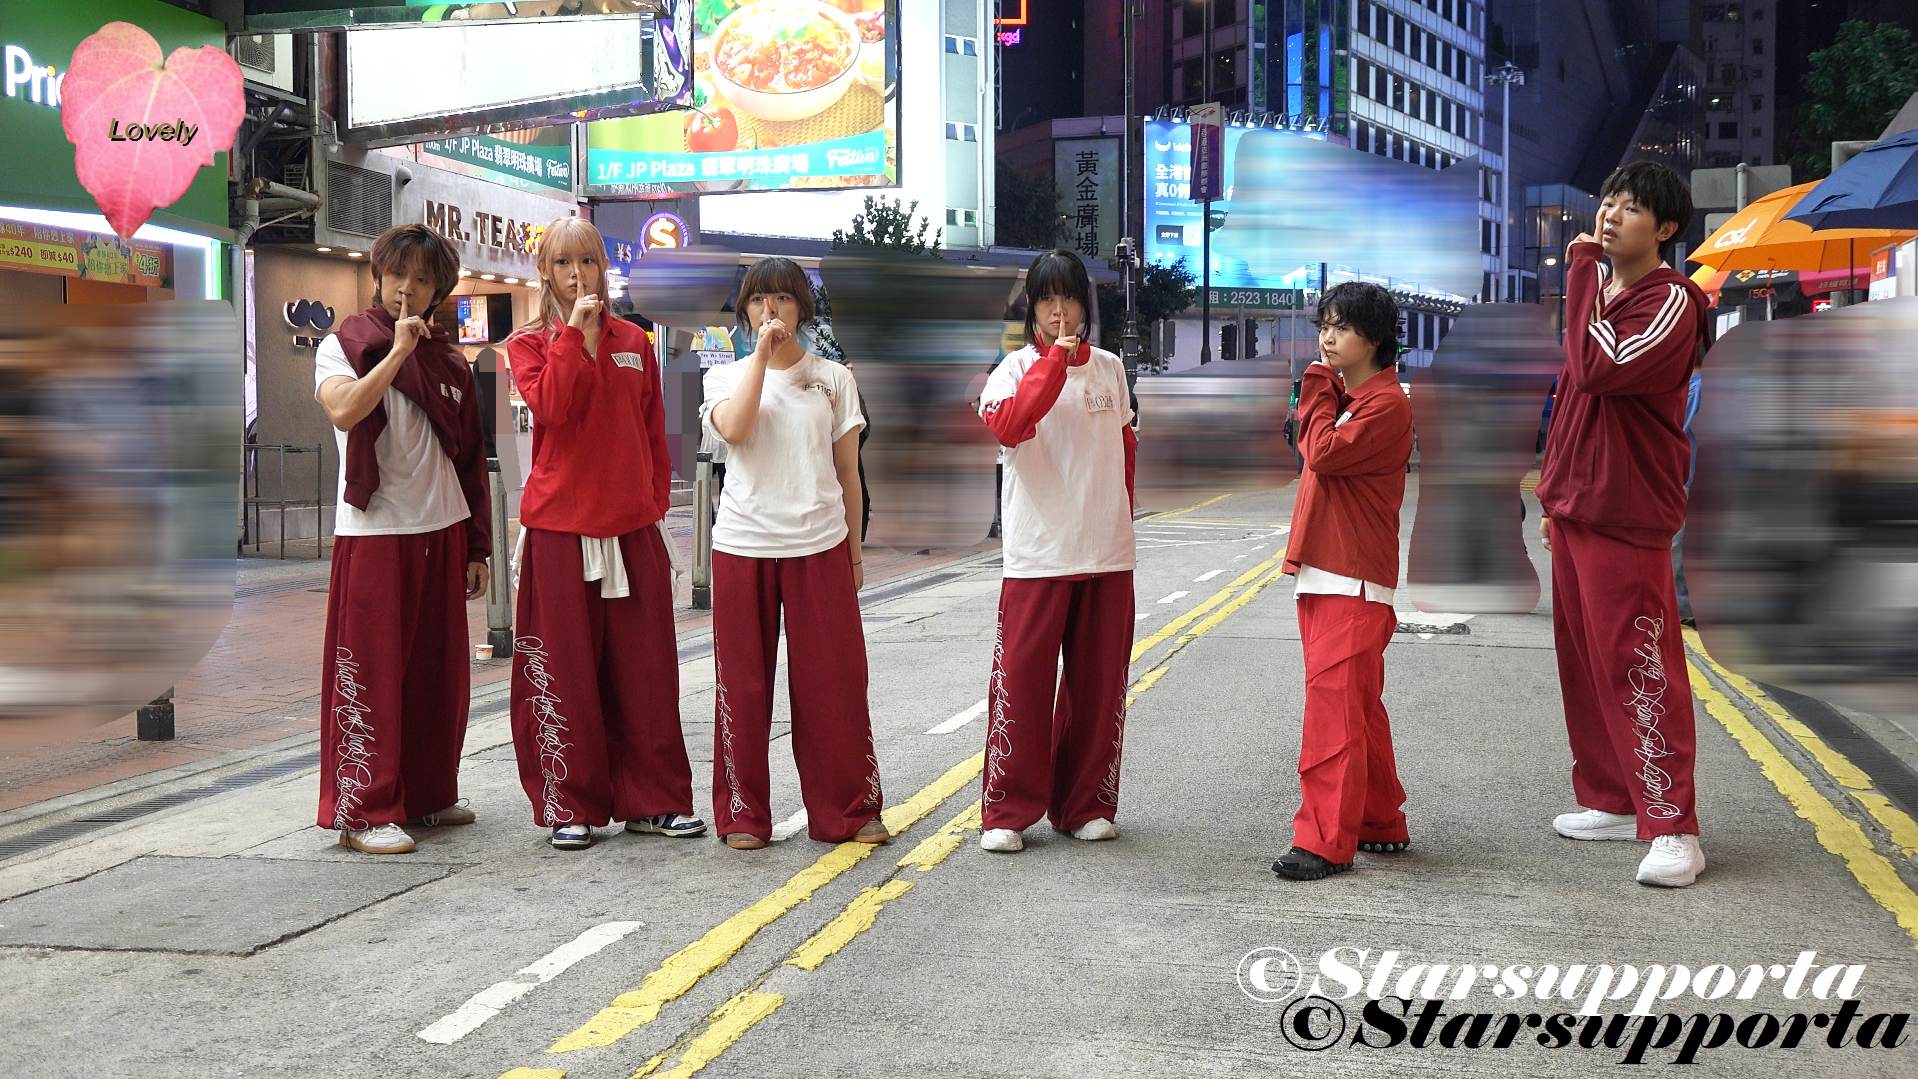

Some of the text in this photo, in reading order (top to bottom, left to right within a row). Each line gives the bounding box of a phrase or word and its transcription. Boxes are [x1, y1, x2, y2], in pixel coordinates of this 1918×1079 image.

[459, 137, 470, 155] JP
[471, 138, 494, 162] Plaza
[597, 162, 623, 180] 1/F
[626, 162, 648, 179] JP
[650, 159, 695, 178] Plaza
[1155, 164, 1191, 180] 全港
[1074, 150, 1099, 259] 黃金廣場
[424, 200, 520, 252] MR. TEA
[1231, 291, 1261, 305] 2523
[1265, 292, 1294, 306] 1840
